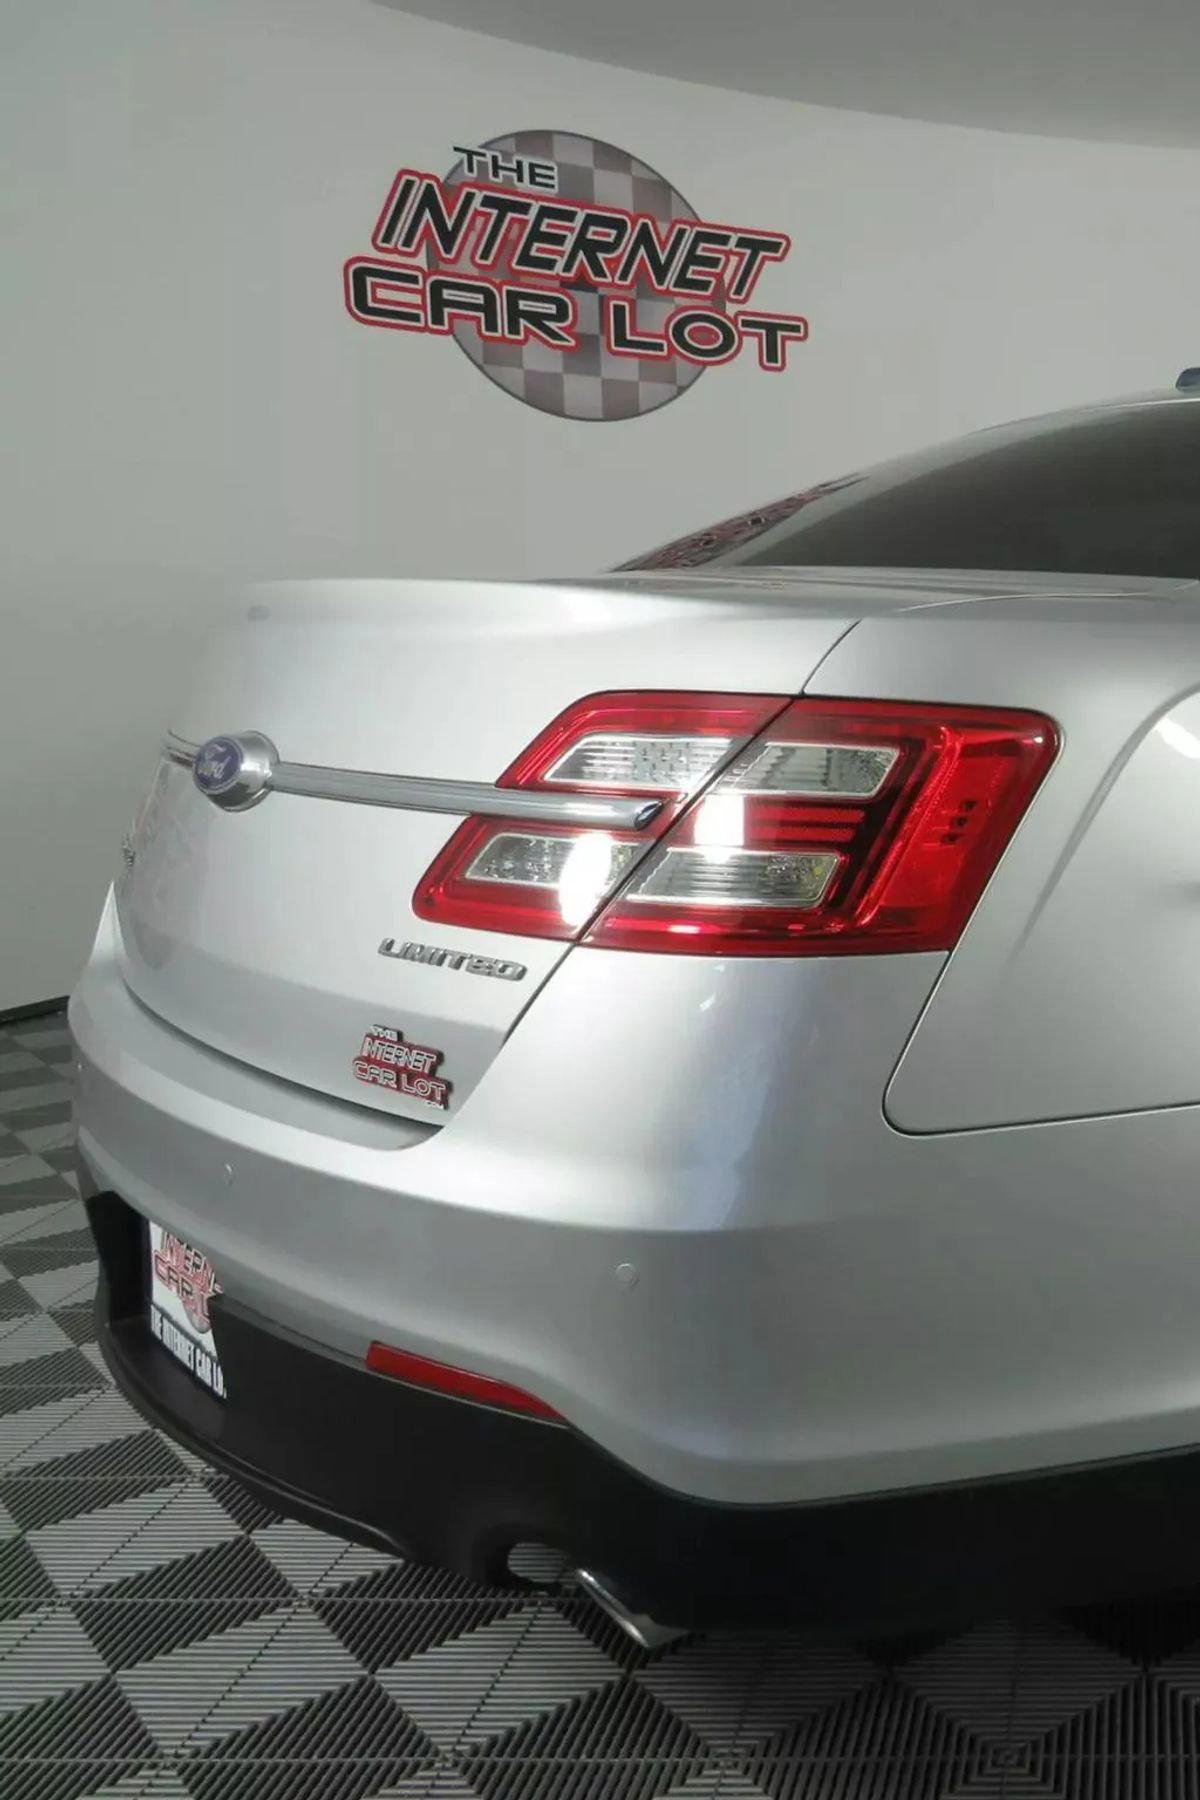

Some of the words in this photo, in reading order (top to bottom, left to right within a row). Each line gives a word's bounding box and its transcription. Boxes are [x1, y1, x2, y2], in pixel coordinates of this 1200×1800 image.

[453, 146, 557, 191] THE
[376, 173, 788, 300] INTERNET
[348, 261, 576, 348] CAR
[609, 298, 805, 368] LOT
[199, 743, 232, 779] Ford
[377, 937, 528, 982] LIMITED
[362, 1037, 437, 1073] INTERNET
[353, 1060, 398, 1089] CAR
[401, 1074, 446, 1101] LOT
